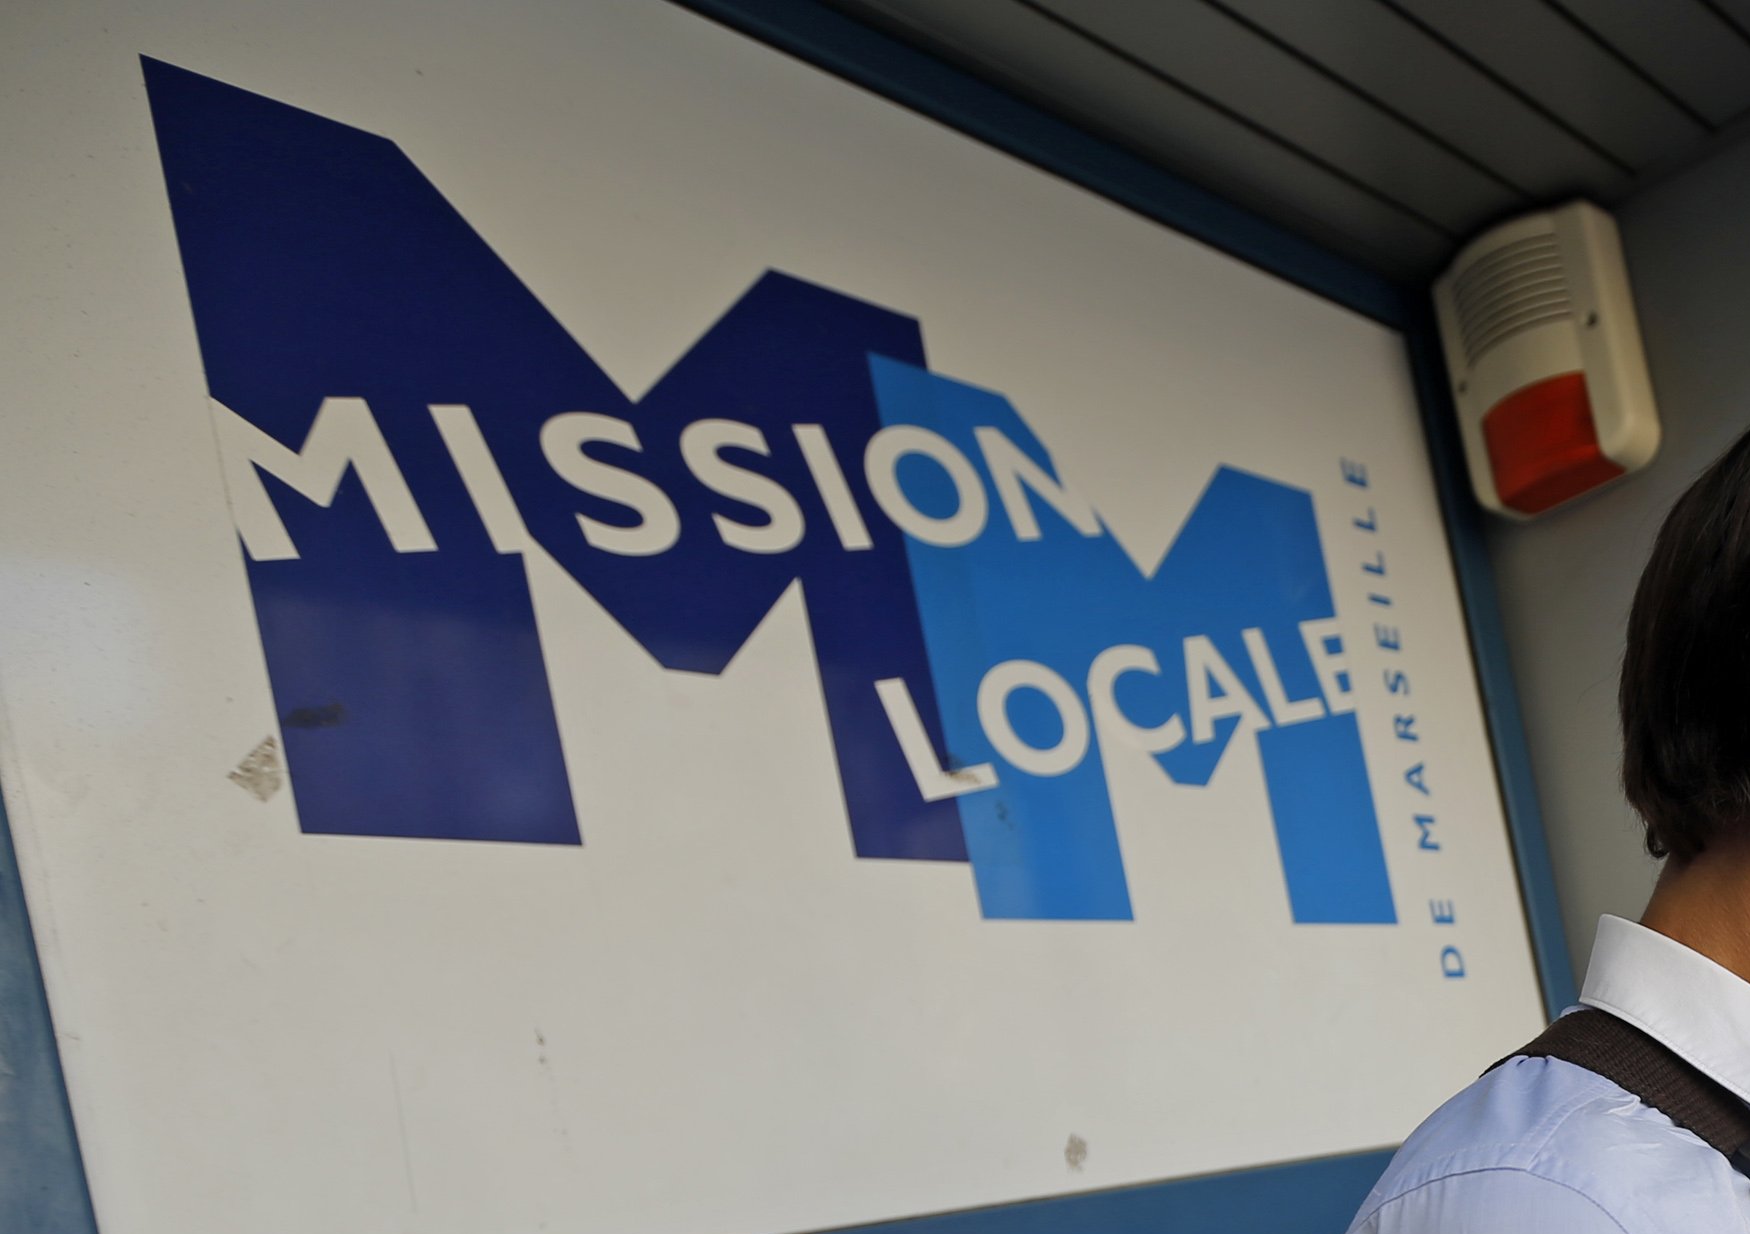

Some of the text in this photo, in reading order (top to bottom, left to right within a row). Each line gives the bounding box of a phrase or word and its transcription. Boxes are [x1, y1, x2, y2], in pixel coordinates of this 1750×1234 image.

[211, 395, 1103, 561] MISSION
[874, 617, 1355, 802] LOCALE
[1340, 457, 1466, 979] DE MARSEILLE
